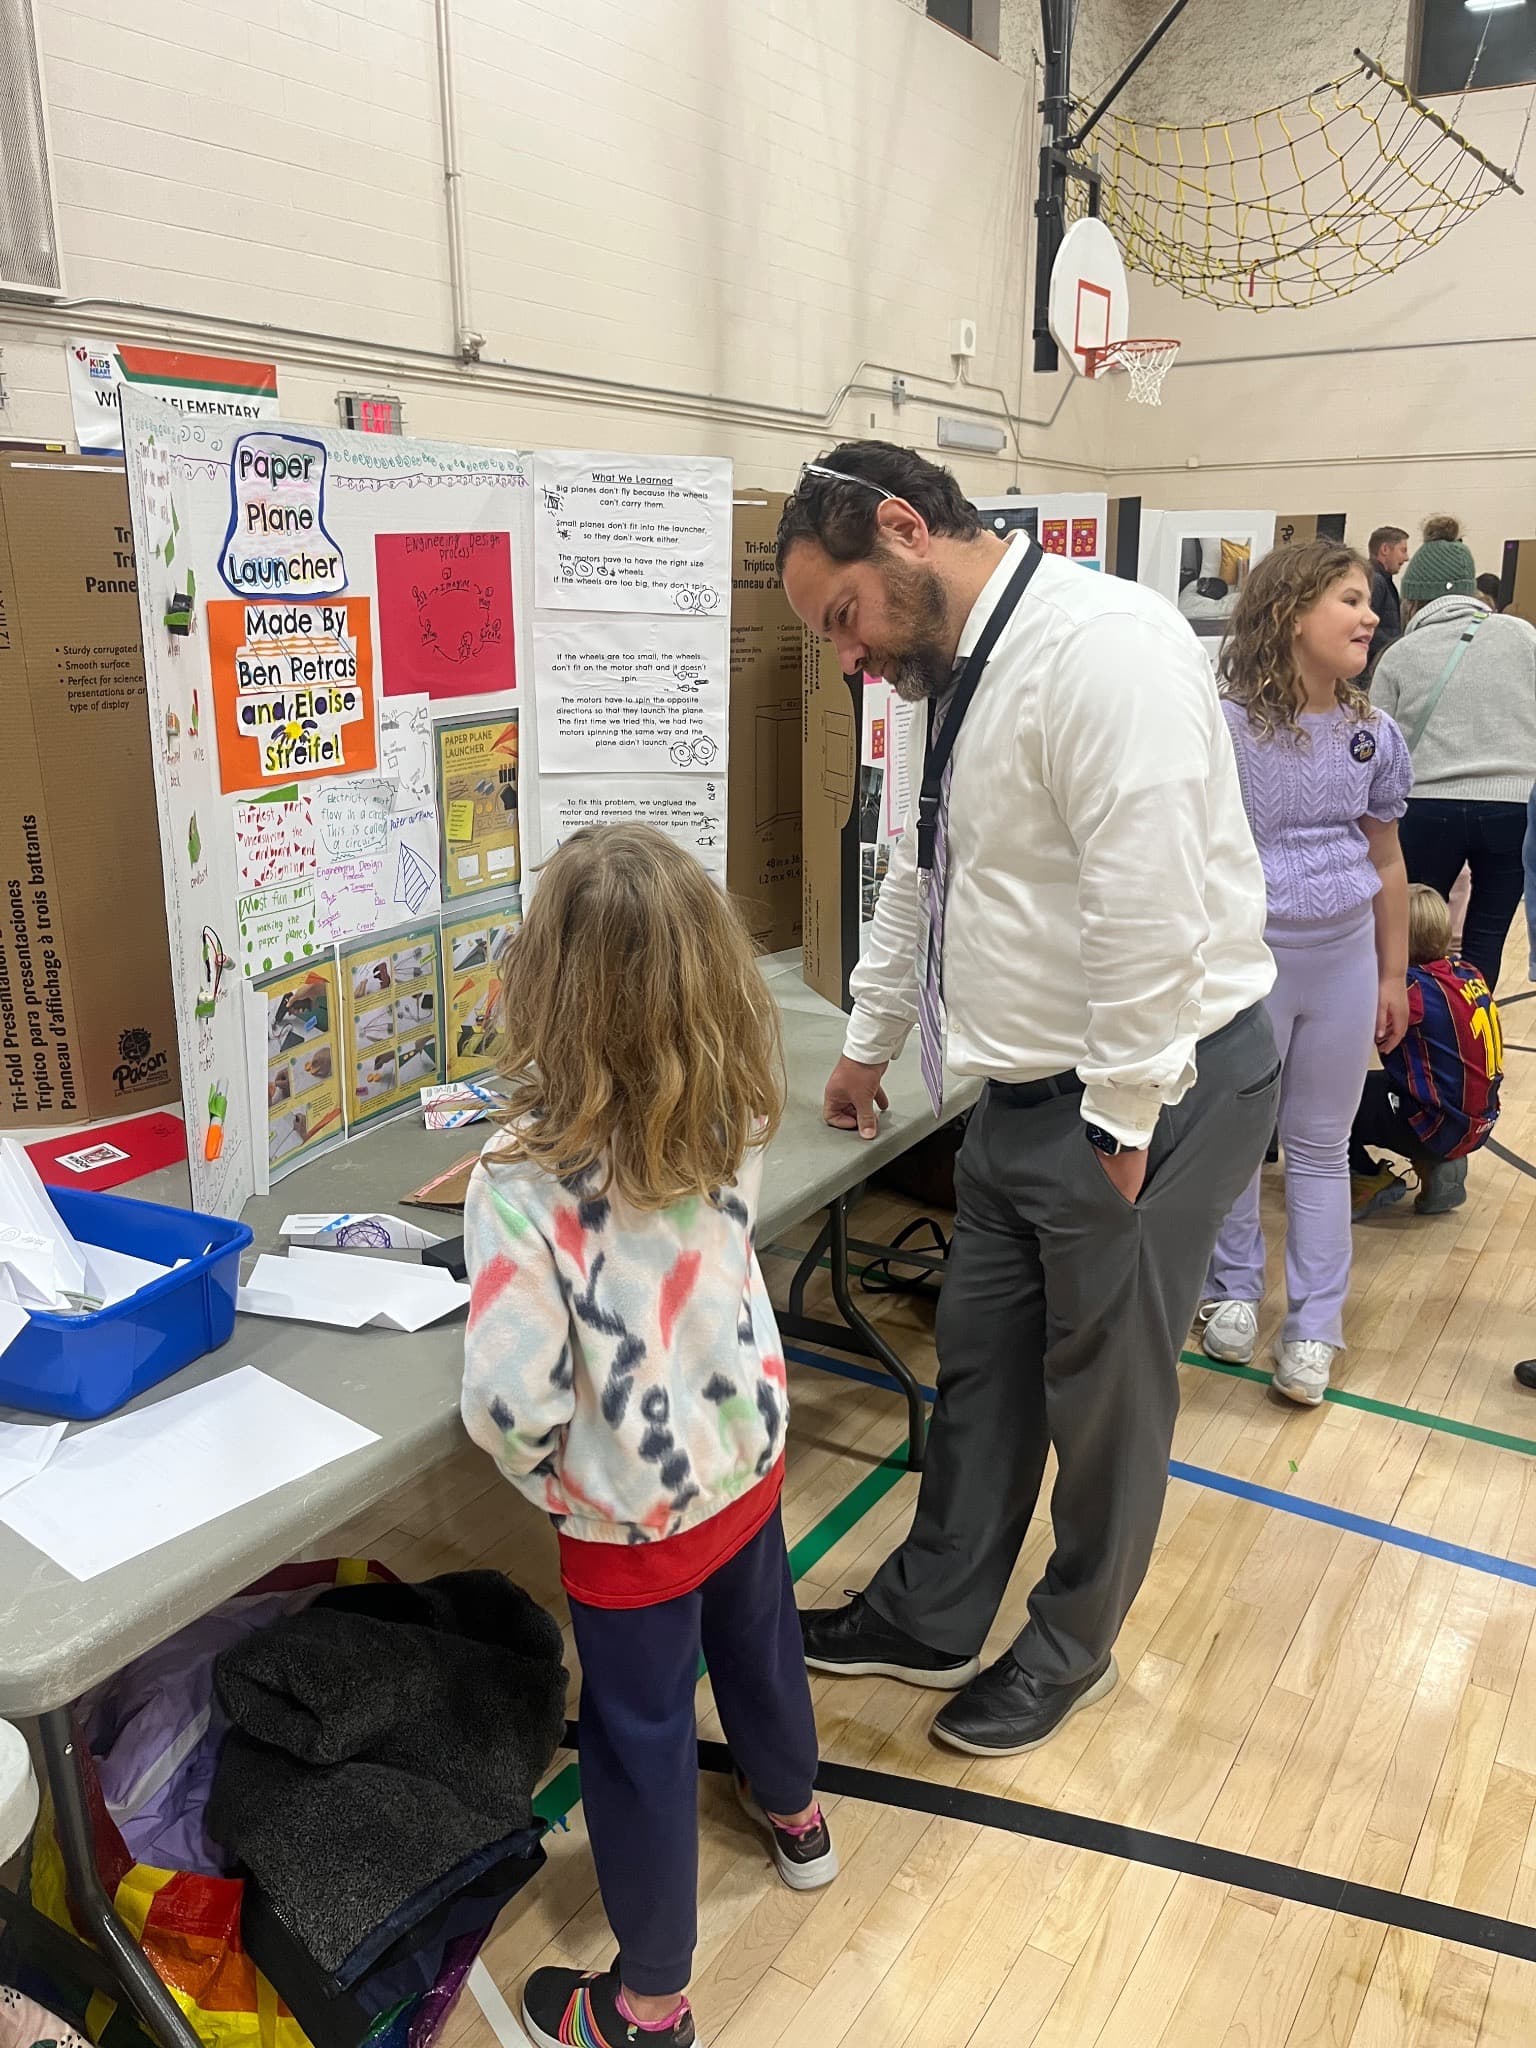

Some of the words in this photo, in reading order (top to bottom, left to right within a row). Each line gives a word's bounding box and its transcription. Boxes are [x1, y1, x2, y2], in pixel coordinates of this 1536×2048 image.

[90, 359, 110, 369] KIDS
[171, 399, 260, 418] ELEMENTARY
[362, 401, 392, 434] EXIT
[239, 449, 313, 488] Paper
[592, 473, 615, 482] What
[619, 474, 632, 483] We
[636, 475, 673, 485] Learned
[556, 485, 568, 494] Big
[571, 486, 596, 494] planes
[622, 488, 630, 496] fly
[683, 491, 708, 499] wheels
[246, 503, 313, 531] Plane
[595, 533, 610, 541] they
[672, 525, 706, 534] launcher,
[469, 534, 499, 549] Design
[574, 555, 600, 563] motors
[229, 554, 338, 585] Launcher
[85, 577, 138, 593] Panne
[562, 575, 573, 583] the
[636, 580, 649, 588] big,
[652, 581, 668, 589] they
[732, 579, 763, 589] anneau
[247, 608, 312, 635] Made
[323, 608, 345, 637] By
[64, 646, 90, 656] Sturdy
[93, 644, 138, 654] corrugated
[66, 661, 98, 670] Smooth
[100, 660, 130, 669] surface
[239, 661, 282, 687] Ben
[291, 656, 356, 682] Petras
[68, 676, 97, 686] Perfect
[100, 676, 111, 684] for
[114, 675, 143, 683] science
[621, 676, 637, 684] spin.
[68, 689, 125, 700] presentations
[70, 703, 89, 712] type
[91, 701, 100, 710] of
[102, 700, 129, 710] display
[242, 695, 285, 725] and
[296, 689, 355, 718] Eloise
[445, 733, 468, 746] PAPER
[470, 730, 492, 742] PLANE
[445, 744, 484, 758] LAUNCHER
[327, 824, 344, 837] This
[353, 825, 359, 835] is
[23, 814, 46, 885] battants
[32, 889, 50, 930] trois
[239, 893, 267, 921] Most
[272, 891, 287, 905] fun
[294, 882, 312, 902] part
[257, 920, 283, 933] making
[288, 915, 299, 925] the
[8, 880, 42, 1006] presentaciones
[37, 933, 54, 944] à
[259, 936, 279, 949] paper
[286, 929, 307, 944] planes
[43, 949, 66, 1037] d'affichage
[27, 1010, 48, 1047] para
[1470, 1002, 1504, 1080] 10
[52, 1042, 77, 1111] Panneau
[112, 1052, 168, 1091] Pacon
[5, 1053, 29, 1112] Tri-Fold
